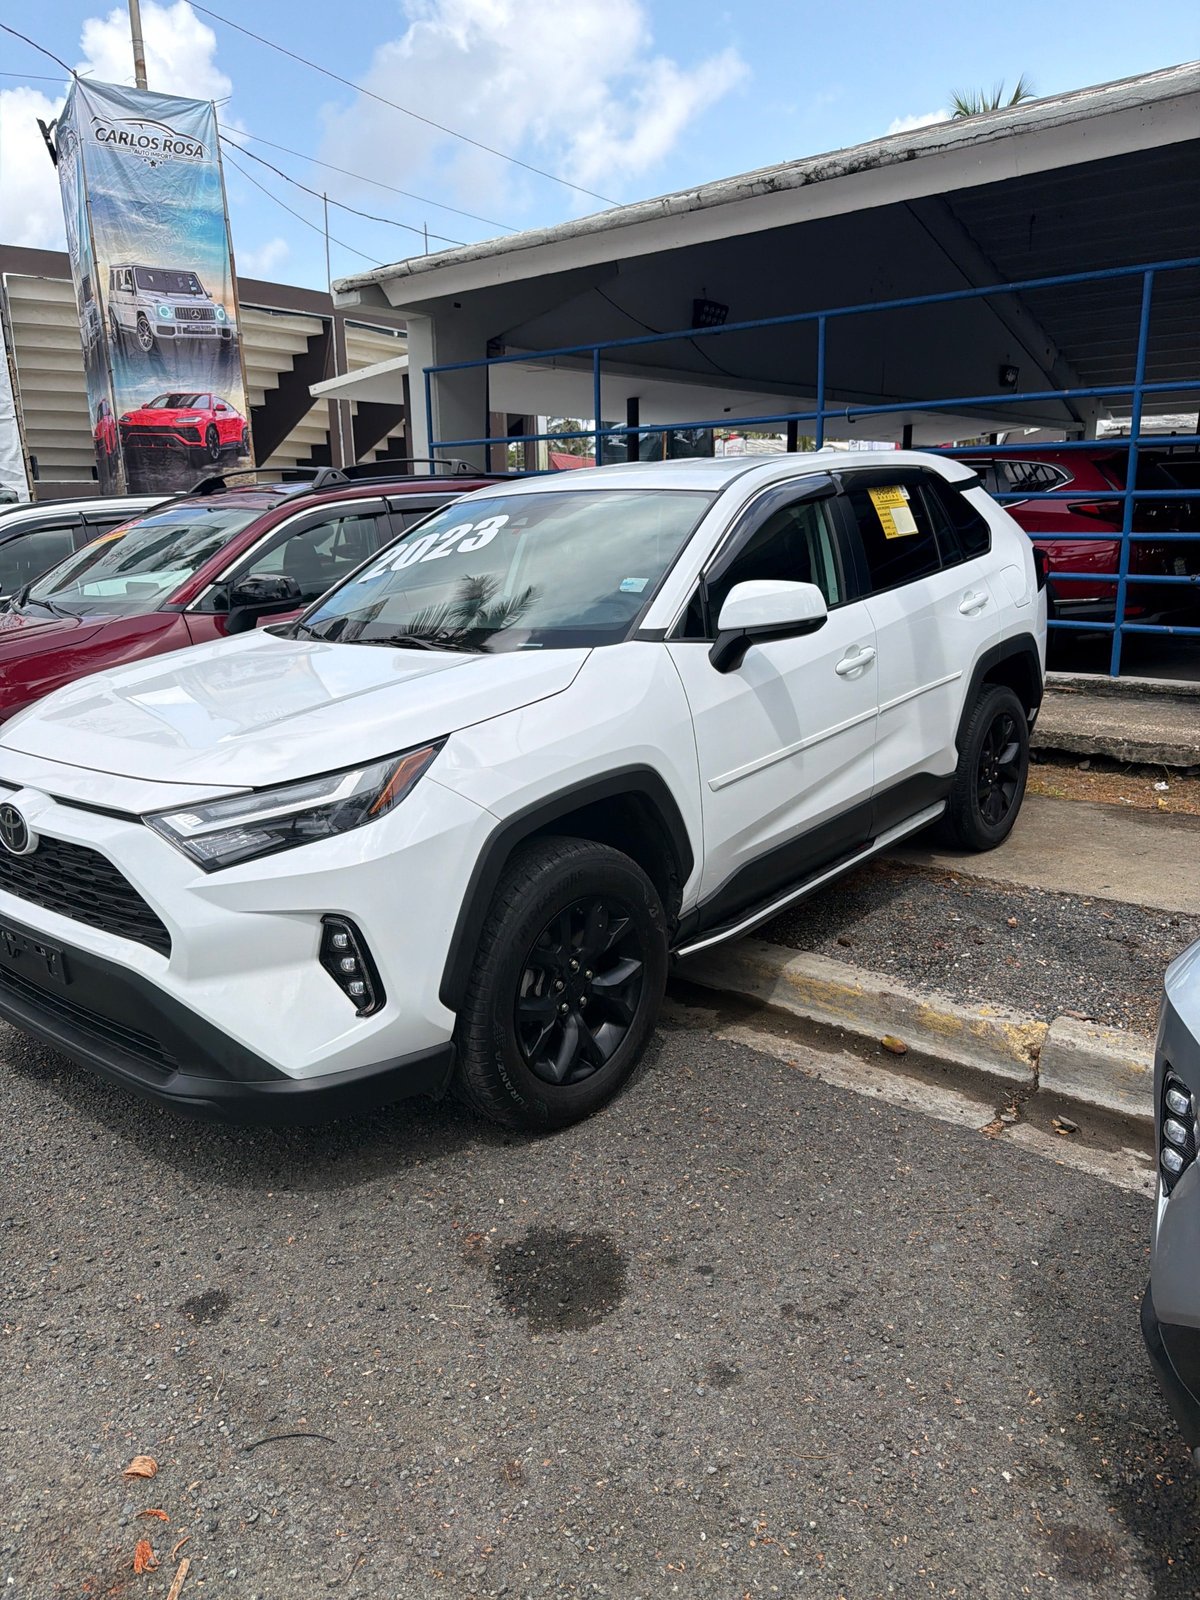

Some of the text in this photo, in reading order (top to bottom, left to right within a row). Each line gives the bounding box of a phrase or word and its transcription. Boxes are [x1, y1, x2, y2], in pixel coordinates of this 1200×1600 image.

[95, 127, 204, 158] CARLOS ROSA
[134, 148, 172, 160] AUTO IMPORT
[357, 515, 510, 584] 2023
